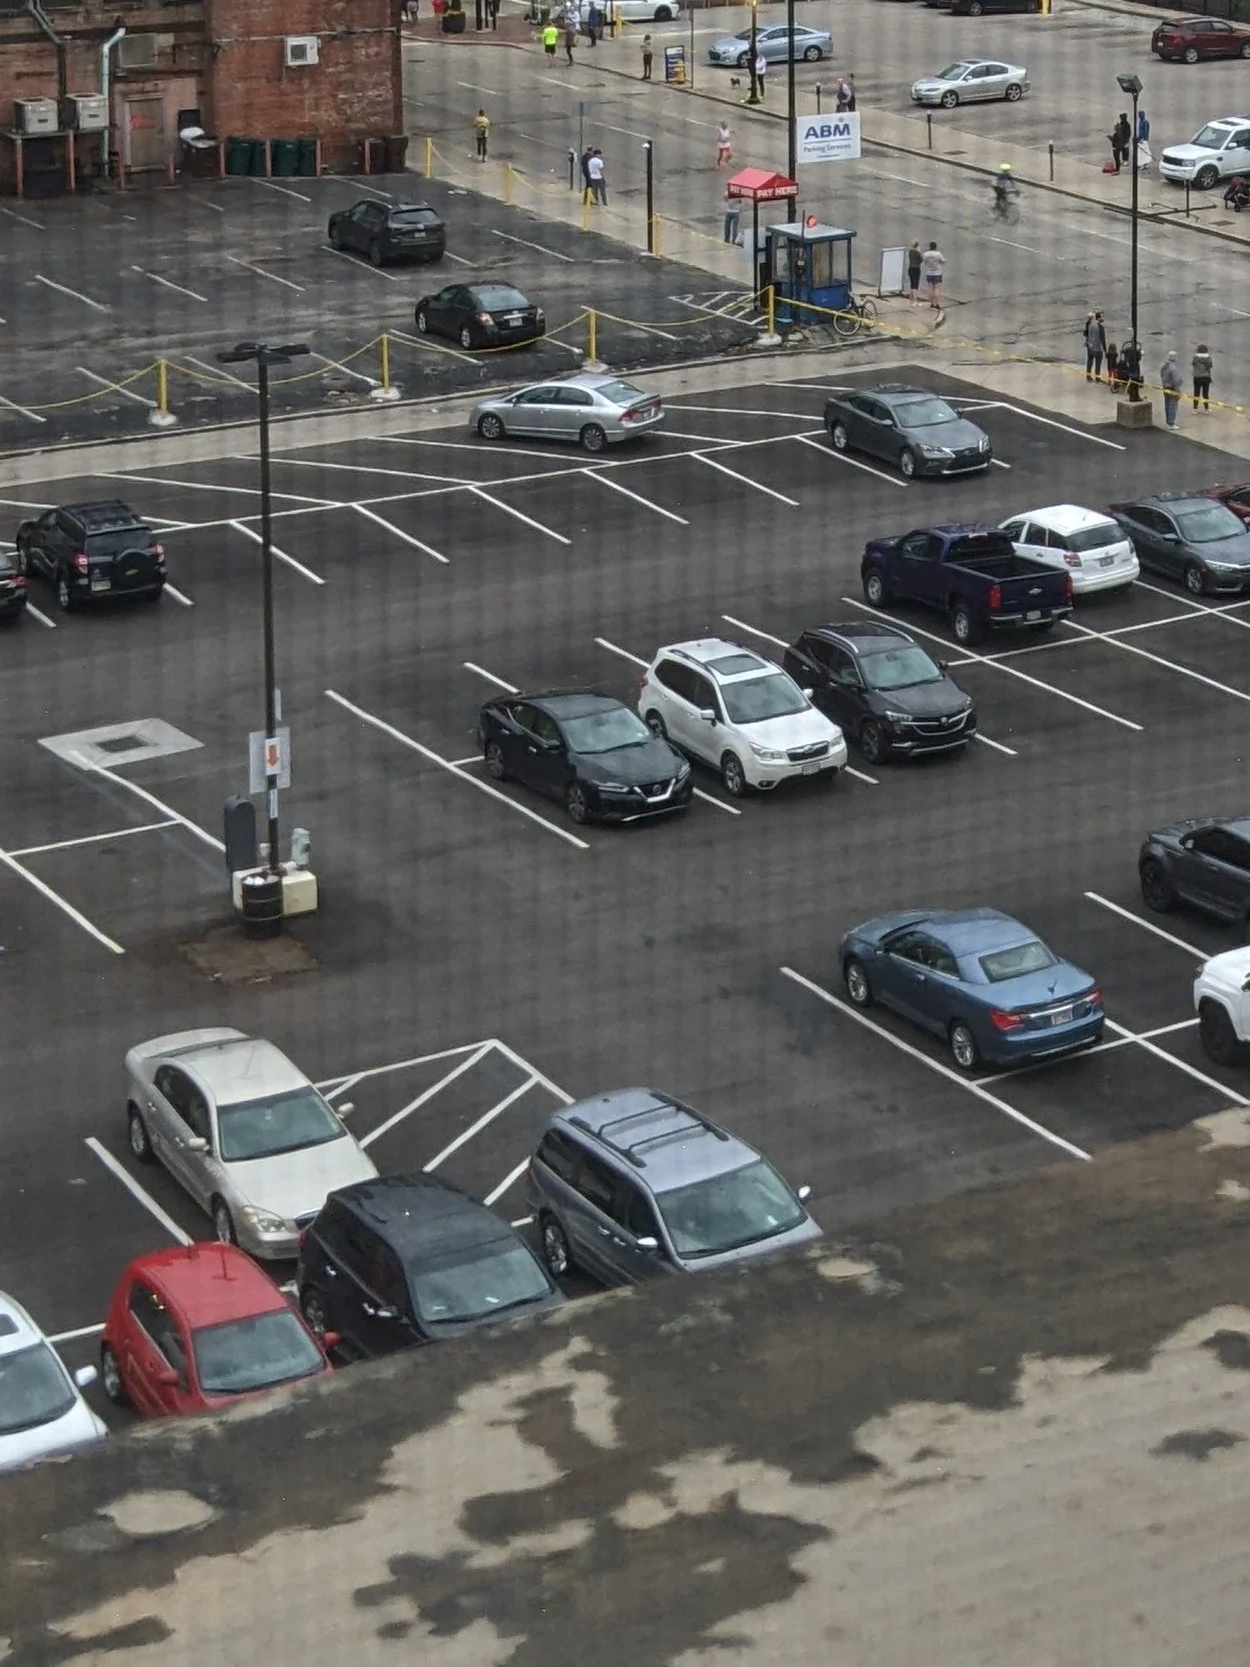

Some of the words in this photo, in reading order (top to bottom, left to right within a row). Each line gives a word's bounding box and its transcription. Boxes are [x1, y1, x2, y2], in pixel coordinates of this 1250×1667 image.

[804, 123, 851, 140] ABM
[803, 145, 826, 153] Parking
[757, 188, 773, 198] PAY
